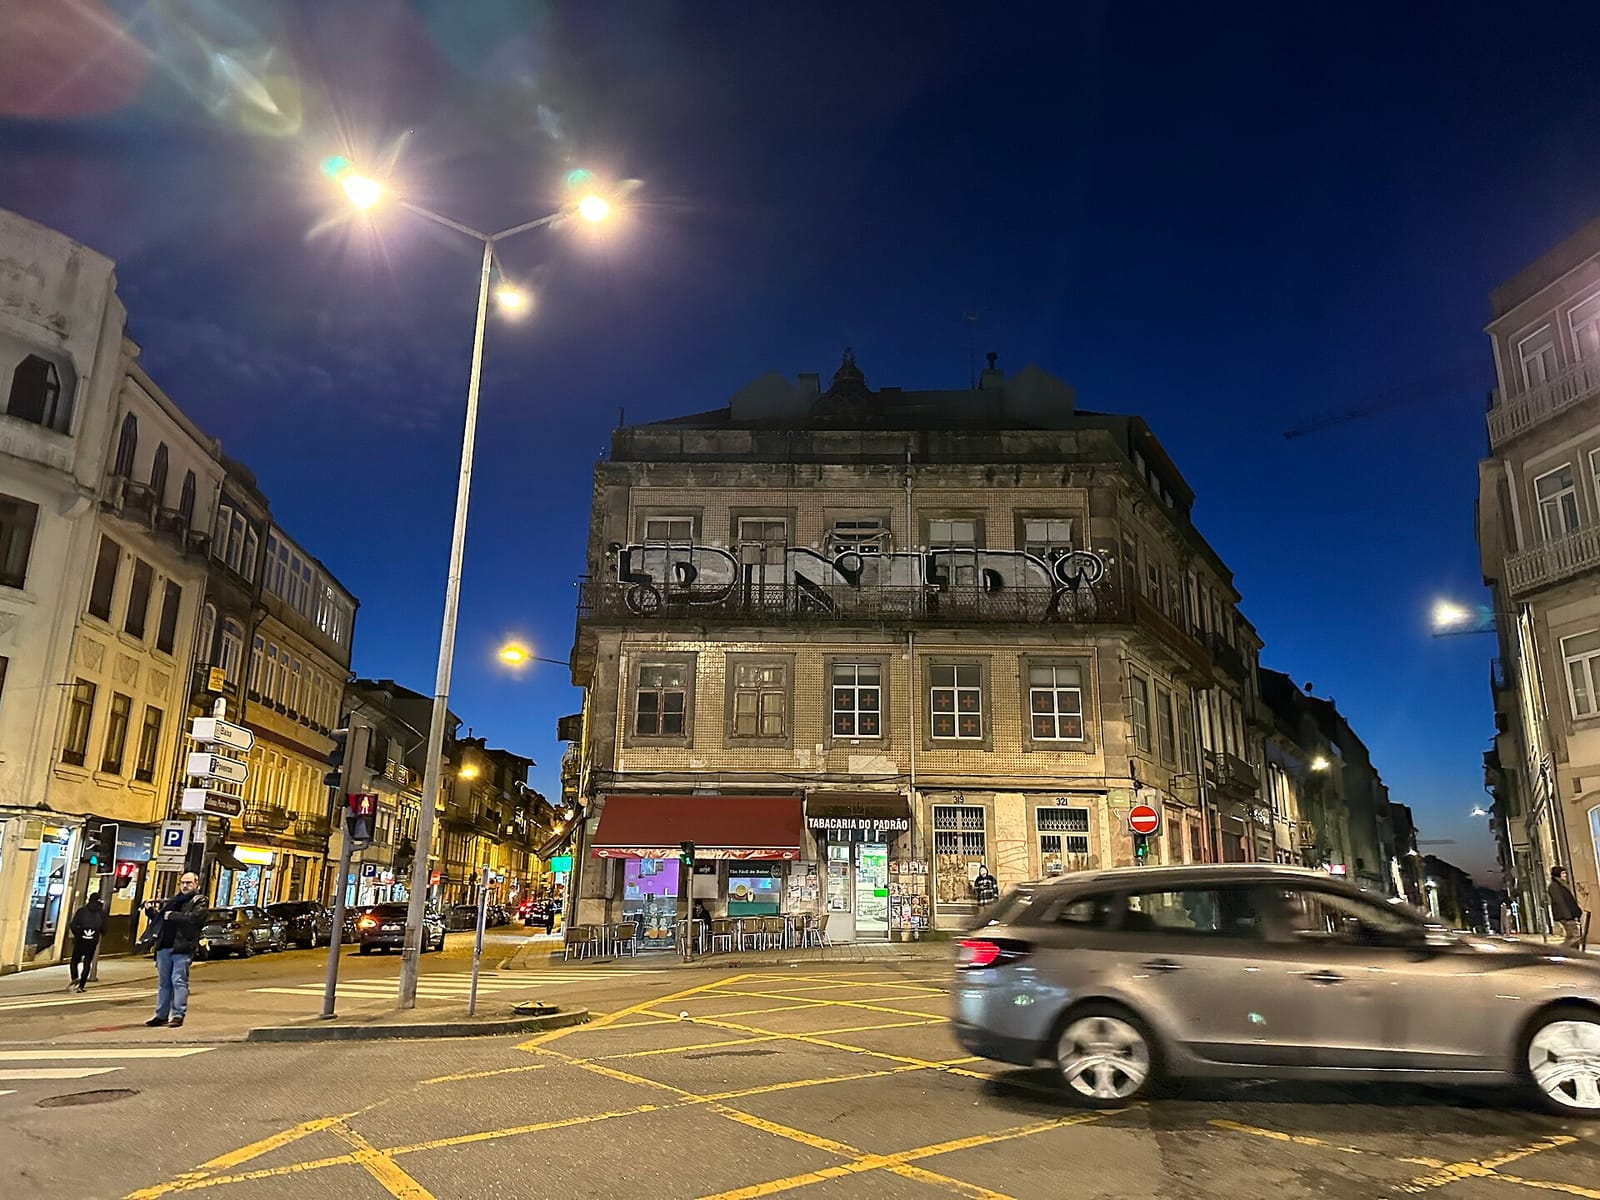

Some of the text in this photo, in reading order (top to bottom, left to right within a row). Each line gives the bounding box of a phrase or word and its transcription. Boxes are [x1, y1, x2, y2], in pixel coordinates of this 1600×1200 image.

[952, 795, 965, 805] 319
[1055, 797, 1068, 807] 321
[808, 817, 908, 831] TABACARIA DO PADRÃO
[166, 830, 180, 846] P
[365, 865, 374, 876] P
